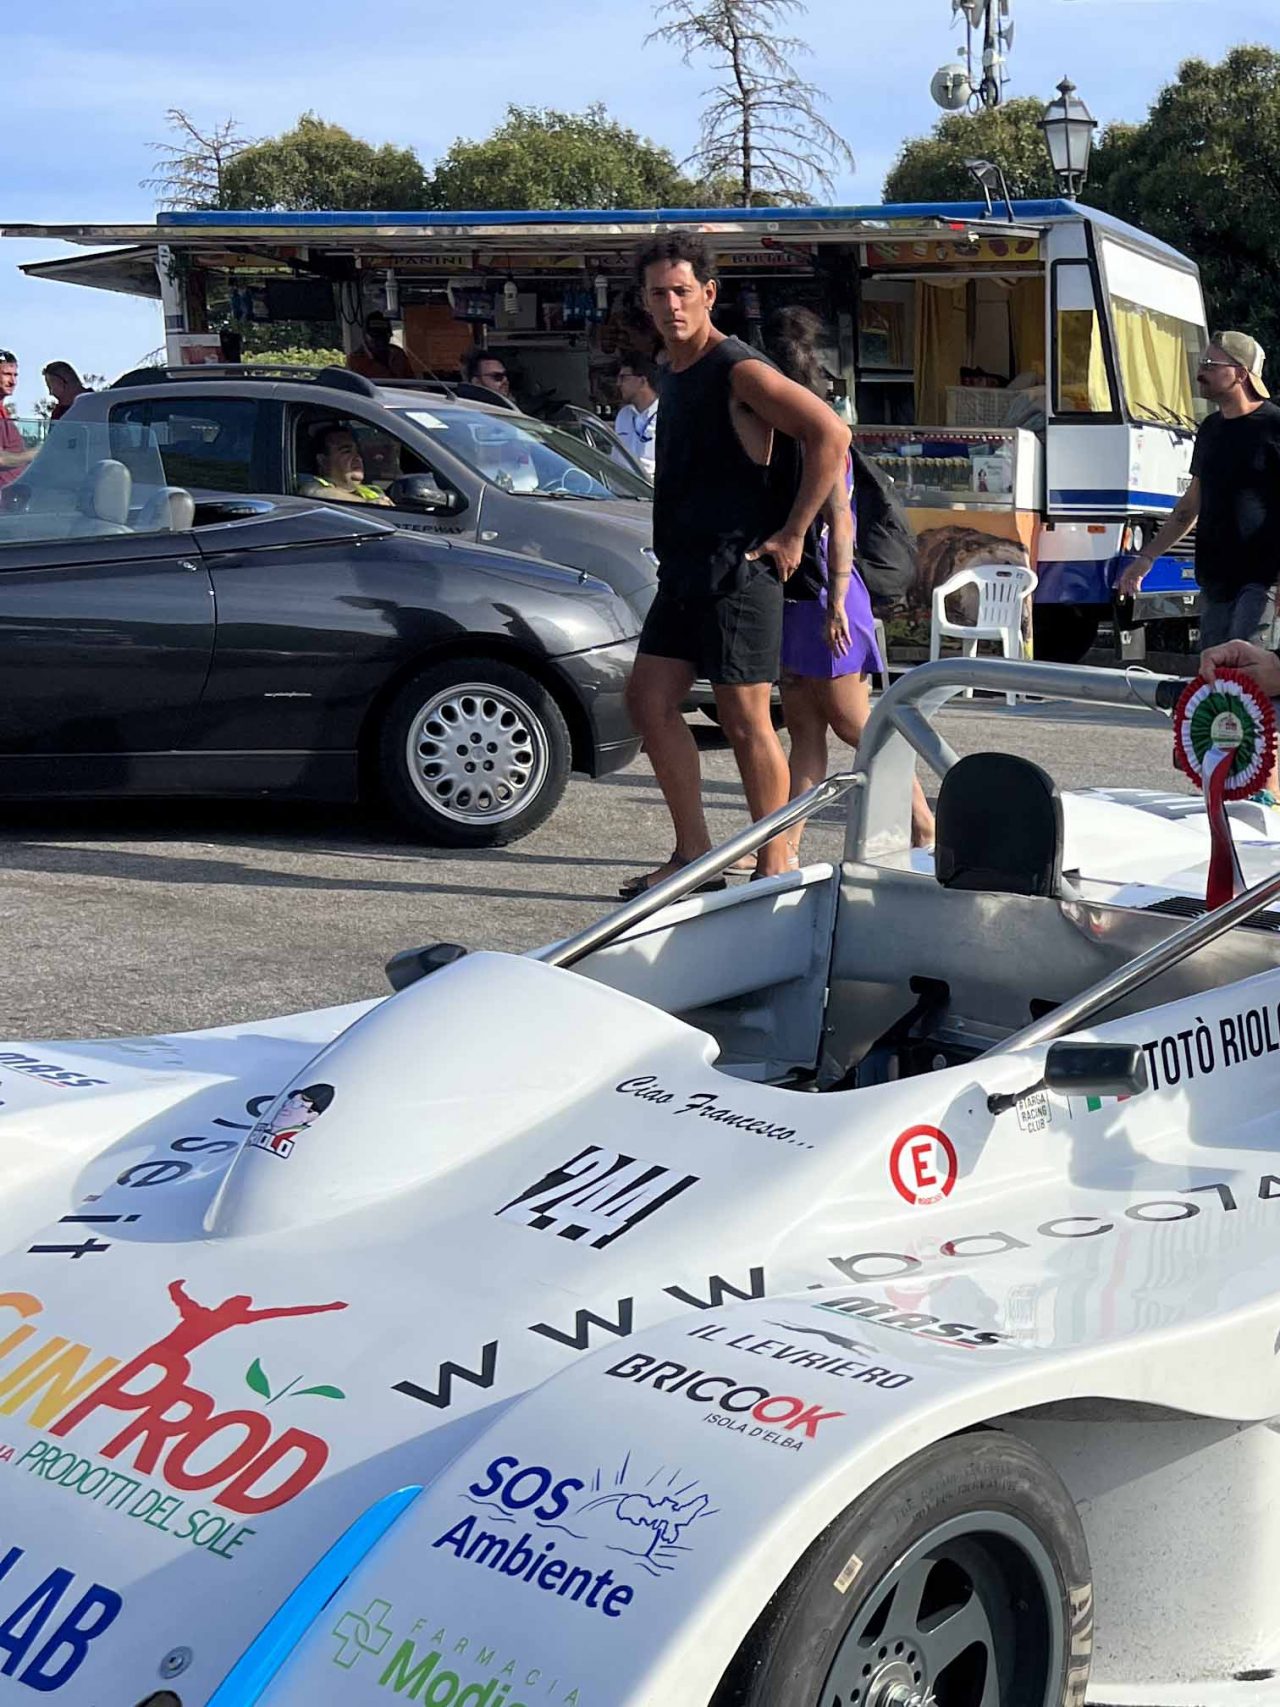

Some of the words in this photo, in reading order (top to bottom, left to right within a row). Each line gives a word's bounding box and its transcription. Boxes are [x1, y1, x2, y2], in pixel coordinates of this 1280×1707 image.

[1142, 1016, 1216, 1091] TOTÒ
[616, 1075, 675, 1104] Ciao
[1021, 1105, 1048, 1120] RACING
[1027, 1119, 1046, 1134] CLUB
[911, 1143, 937, 1188] E
[687, 1324, 728, 1342] IL
[726, 1334, 915, 1389] LEVRIERO
[703, 1412, 745, 1434] ISOLA
[748, 1426, 804, 1451] D'ELBA
[15, 1440, 141, 1510] PRODOTTI
[128, 1488, 184, 1532] DEL
[174, 1509, 256, 1559] SOLE
[468, 1455, 585, 1521] SOS
[431, 1514, 635, 1618] Ambiente
[0, 1546, 123, 1691] AB
[410, 1618, 580, 1707] FARMACIA
